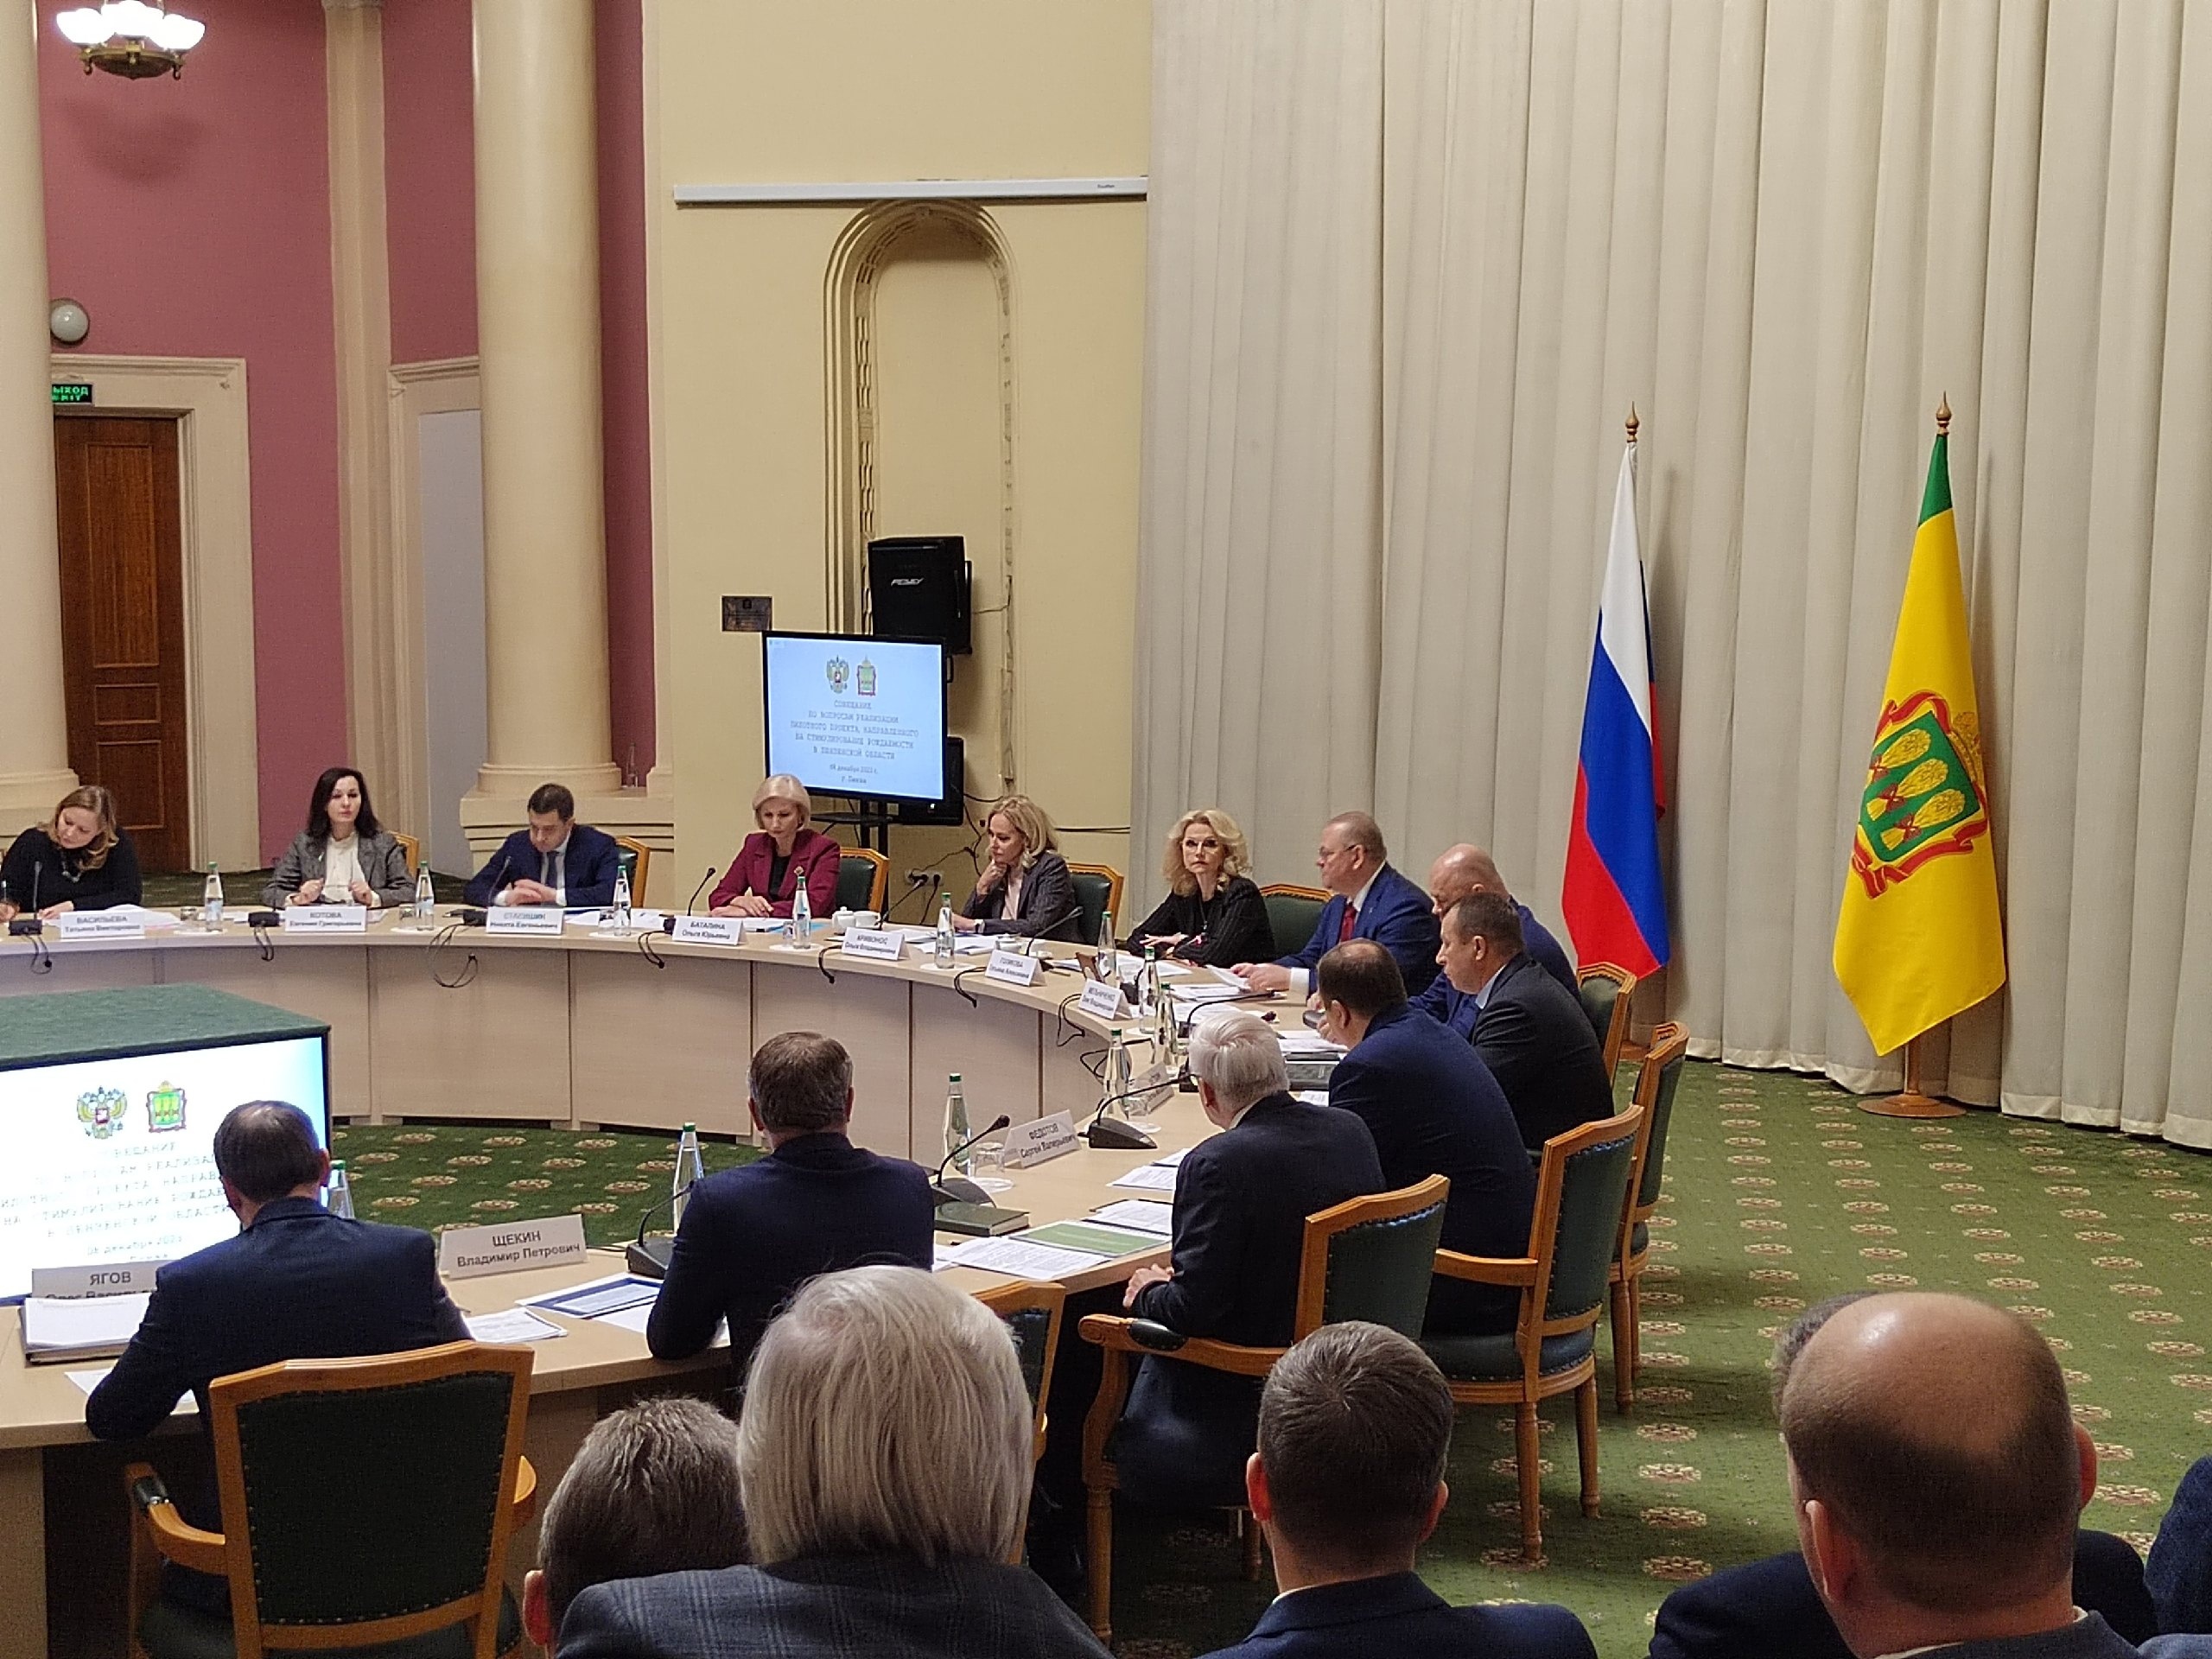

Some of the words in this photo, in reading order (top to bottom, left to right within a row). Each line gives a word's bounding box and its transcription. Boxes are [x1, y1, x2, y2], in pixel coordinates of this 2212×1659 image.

[53, 385, 89, 396] ЫХОД
[1028, 1122, 1059, 1140] ФЕДОТОВ
[492, 1230, 542, 1248] ЩЕКИН
[457, 1252, 520, 1268] Владимир
[523, 1243, 581, 1259] Петрович
[89, 1271, 131, 1286] ЯГОВ
